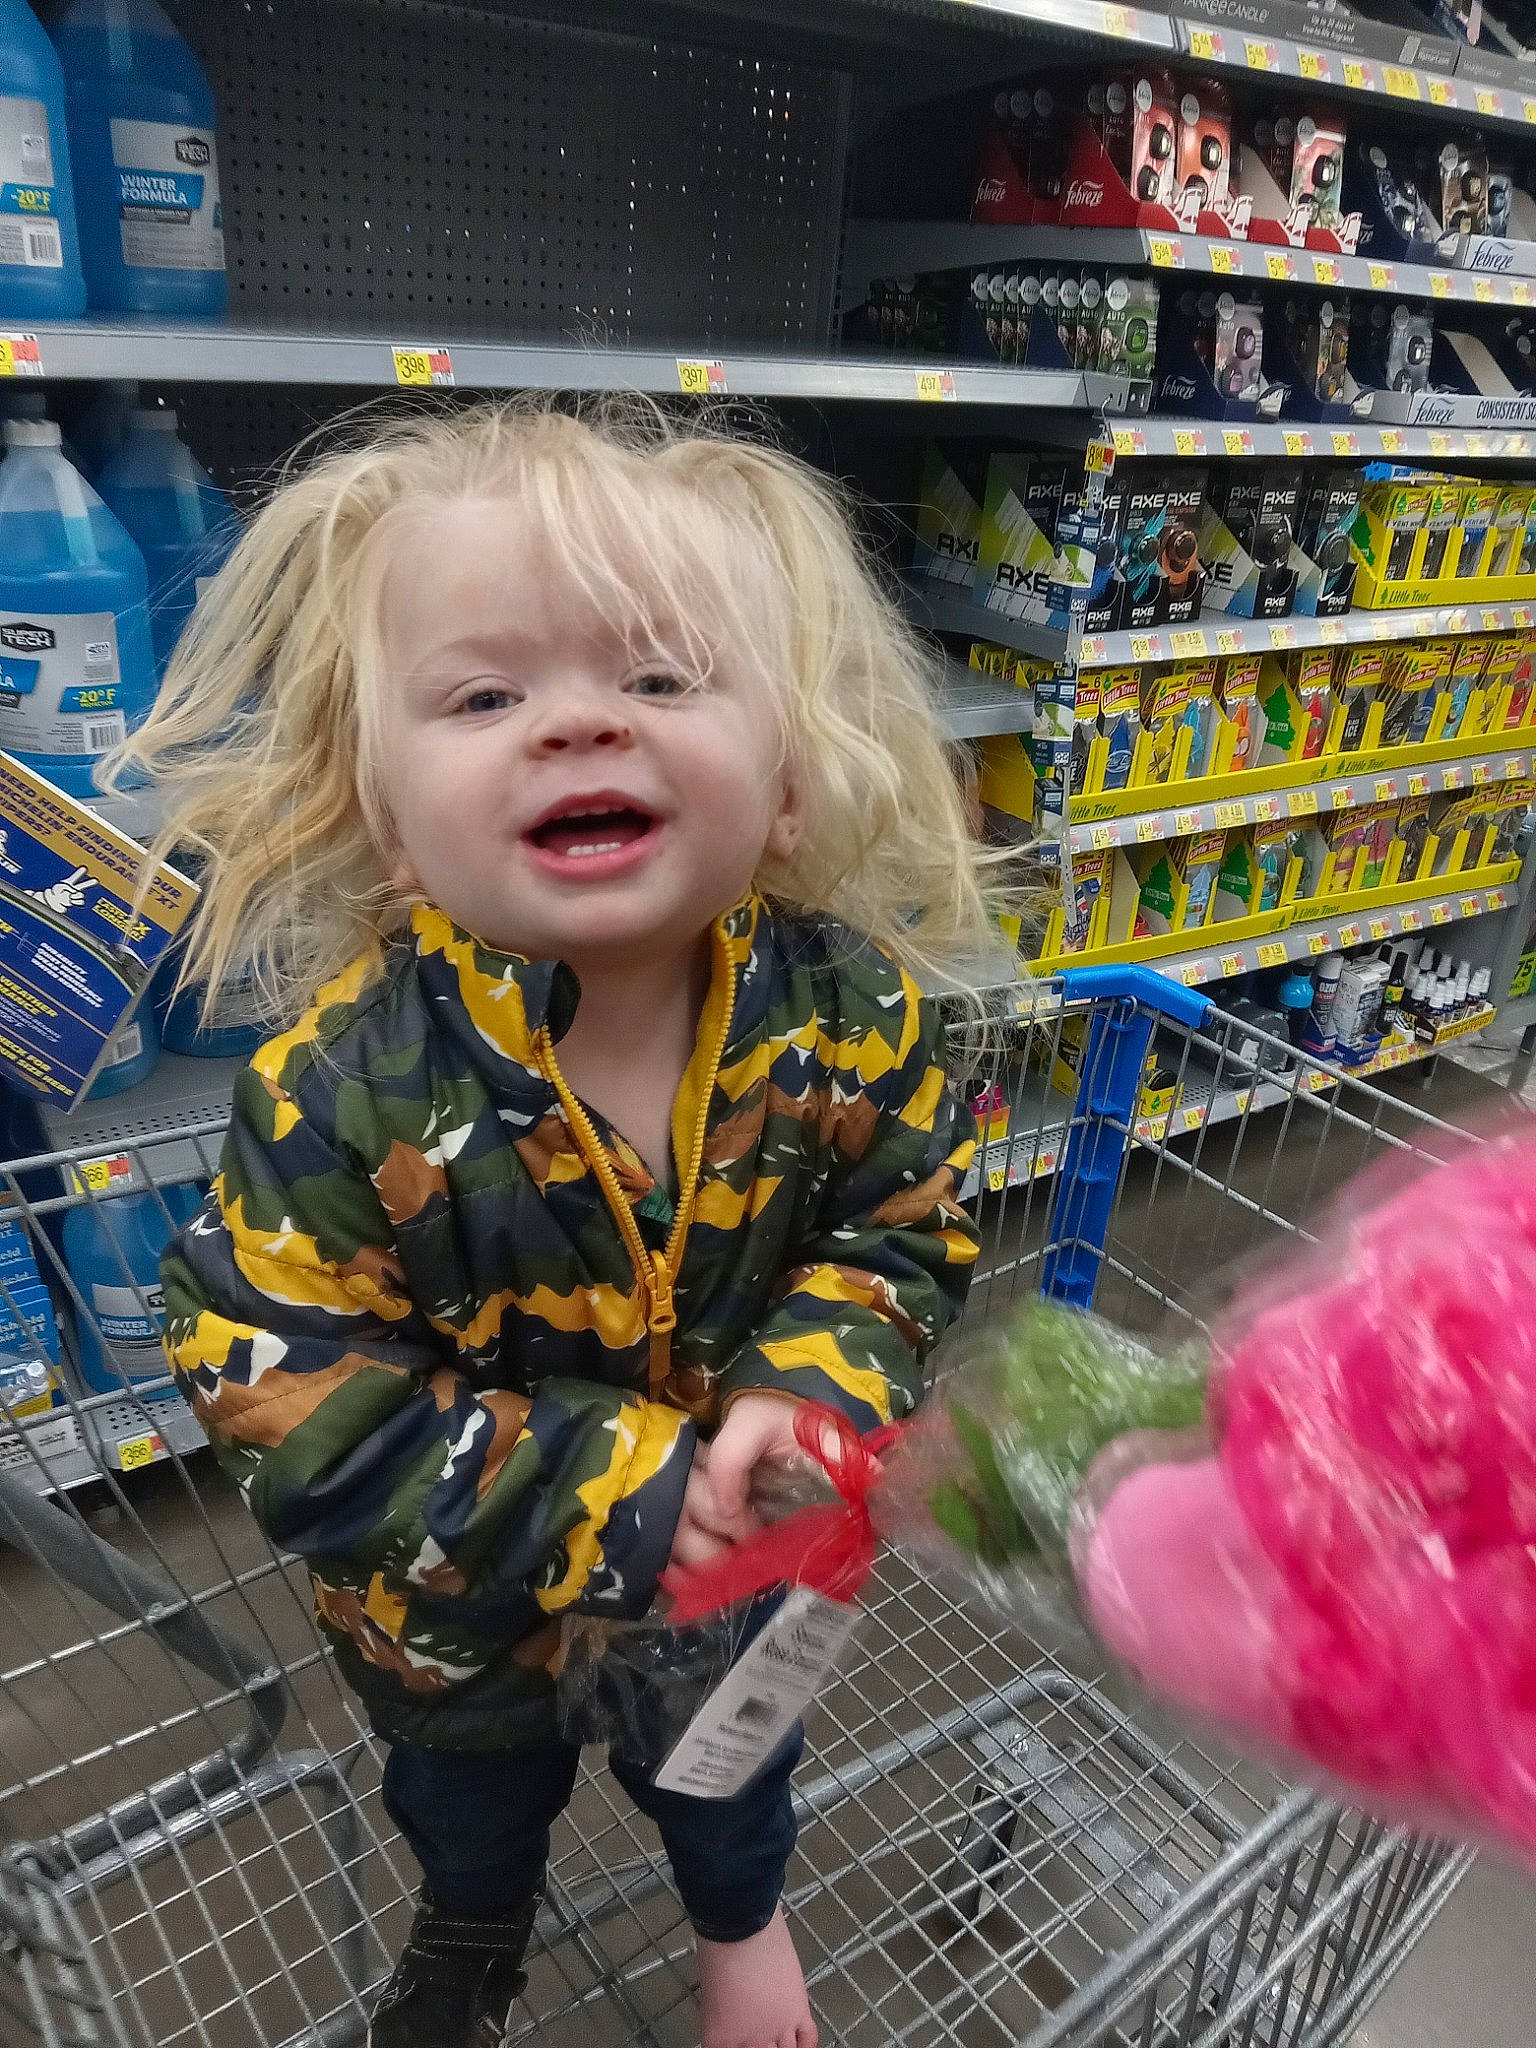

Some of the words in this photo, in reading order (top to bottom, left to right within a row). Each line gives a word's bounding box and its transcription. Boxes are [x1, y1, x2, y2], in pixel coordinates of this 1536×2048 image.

[120, 174, 176, 191] WINTER
[121, 187, 188, 205] FORMULA
[1064, 180, 1104, 210] febreze
[1469, 239, 1514, 271] febreze
[1107, 311, 1126, 321] AUTO
[401, 355, 427, 375] 398
[682, 367, 705, 386] 397
[920, 377, 937, 392] 497
[1160, 374, 1197, 400] febreze
[1413, 397, 1456, 426] febreze
[1476, 399, 1526, 421] CONSISTENT
[1029, 485, 1063, 500] AXE
[1166, 492, 1201, 507] AXE
[1230, 486, 1261, 501] AXE
[1263, 490, 1297, 506] AXE
[1329, 491, 1358, 506] AXE
[1131, 493, 1165, 510] AXE
[997, 562, 1050, 595] AXE
[1198, 558, 1234, 584] XE
[1264, 597, 1286, 607] AXE
[1328, 595, 1347, 606] AXE
[1389, 589, 1410, 604] Little
[1412, 589, 1432, 602] Trees
[1132, 607, 1155, 619] AXE
[1169, 601, 1193, 613] AXE
[1087, 610, 1111, 623] AXE
[1, 628, 50, 638] SUPER
[2, 635, 51, 648] TECH
[1132, 640, 1149, 659] 398
[1218, 634, 1233, 652] 398
[72, 688, 116, 703] -20°F
[1080, 691, 1098, 702] Trees
[1104, 689, 1121, 705] Little
[1121, 683, 1137, 694] Trees
[1345, 726, 1358, 738] ICE
[1345, 760, 1365, 773] Little
[1369, 758, 1387, 770] Trees
[1094, 802, 1117, 817] Trees
[0, 770, 38, 797] NEED
[37, 798, 78, 825] HELP
[76, 825, 141, 868] FINDING
[151, 878, 183, 898] OUR
[1094, 828, 1109, 847] 494
[1138, 822, 1153, 840] 494
[1177, 815, 1191, 833] 494
[1085, 861, 1102, 872] Trees
[155, 895, 179, 910] XT
[39, 943, 89, 976] DURABILITY
[30, 959, 59, 978] WATER
[34, 954, 60, 971] WEAR
[57, 971, 105, 1002] RESISTANCE
[0, 977, 59, 1017] WEATHER
[0, 1037, 28, 1057] HECK
[25, 1055, 52, 1072] FOR
[16, 1059, 44, 1077] SIZE
[101, 1319, 149, 1330] WINTER
